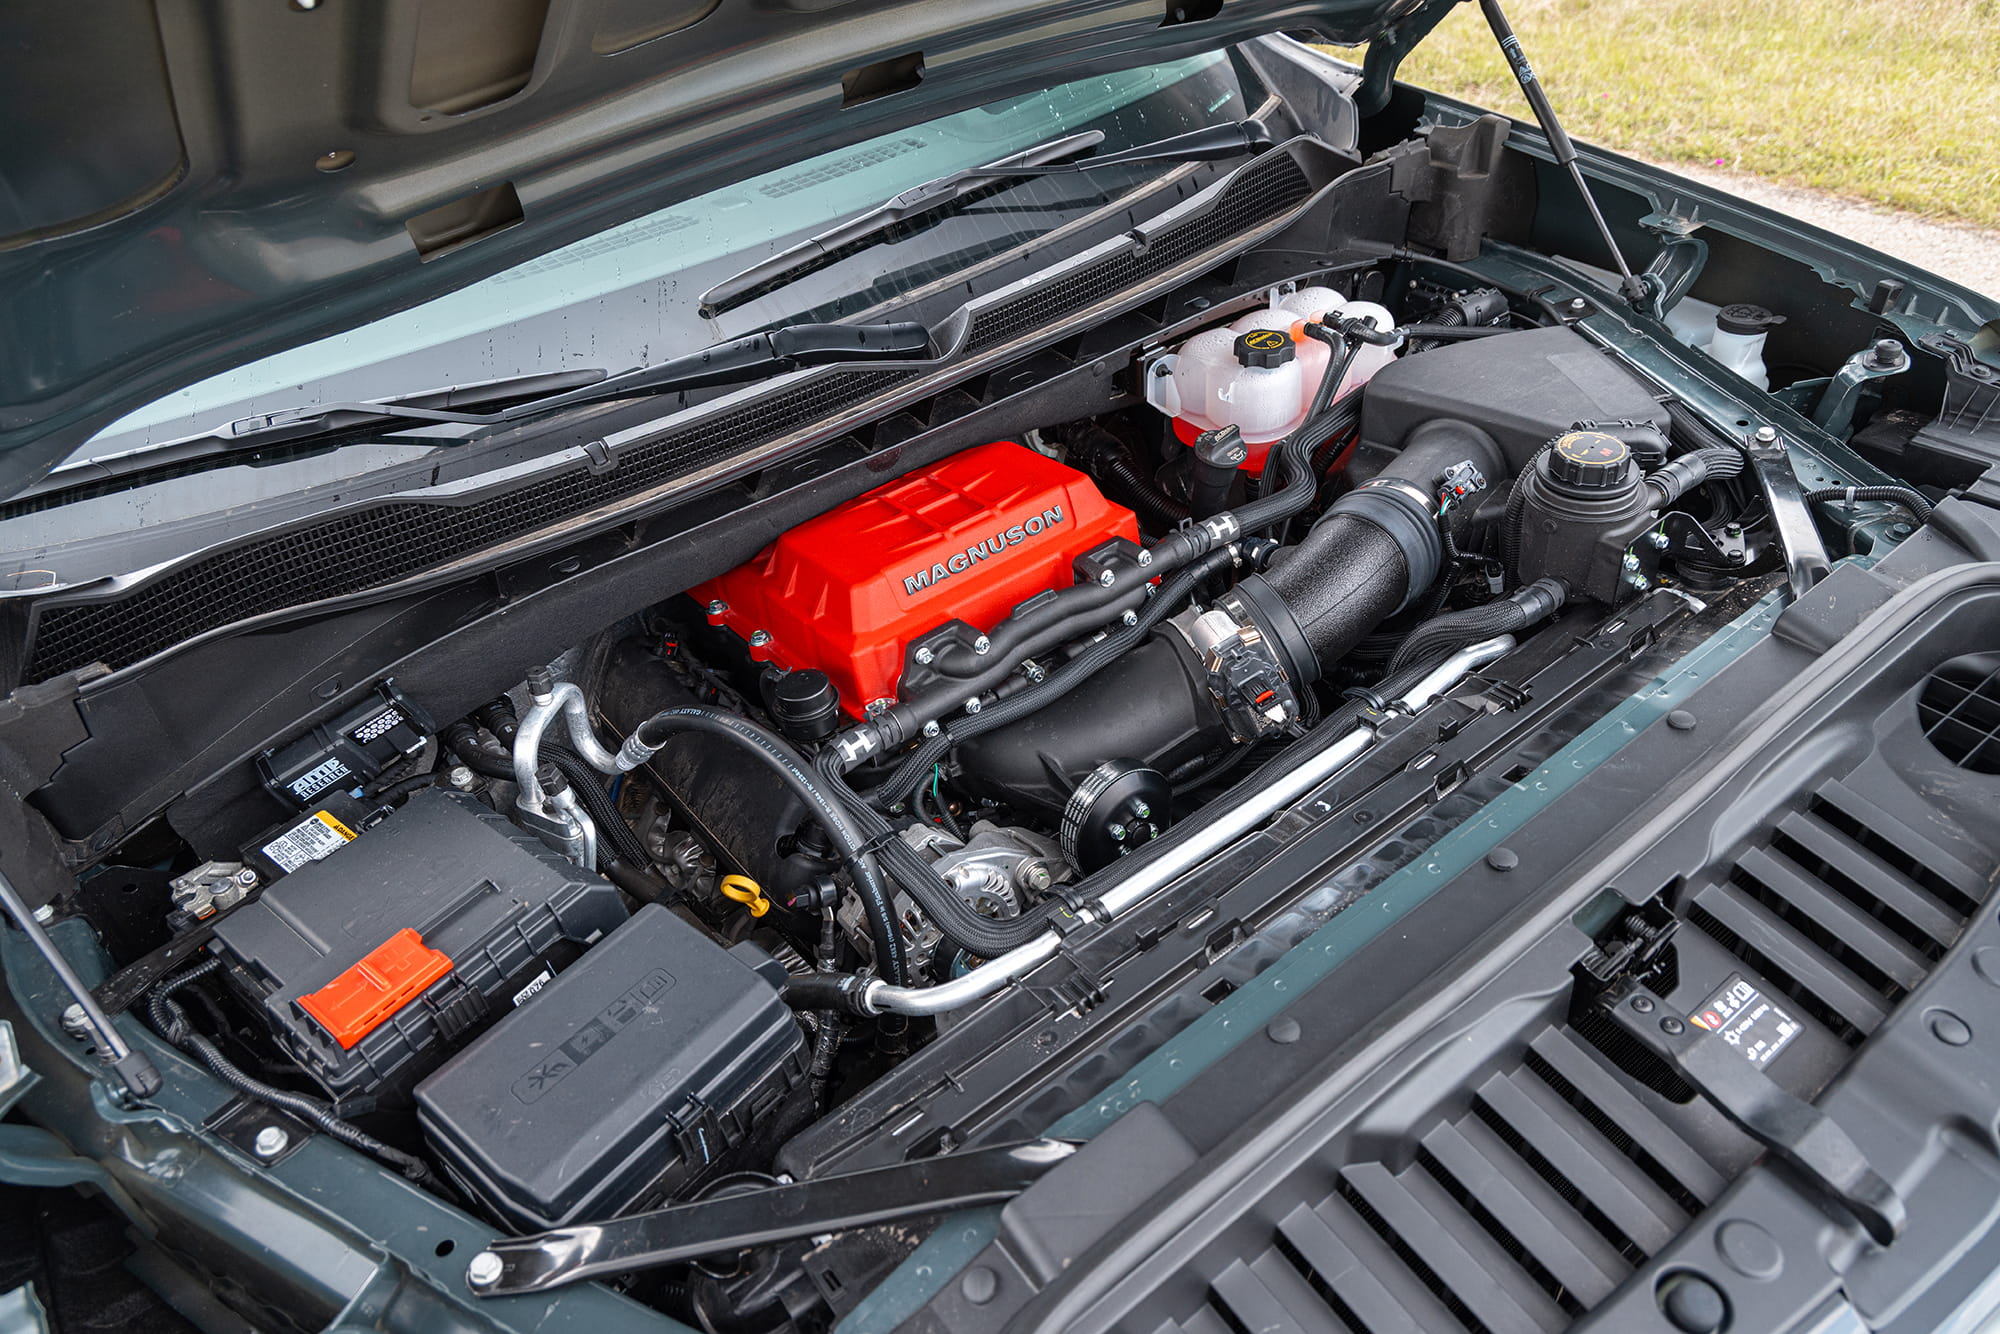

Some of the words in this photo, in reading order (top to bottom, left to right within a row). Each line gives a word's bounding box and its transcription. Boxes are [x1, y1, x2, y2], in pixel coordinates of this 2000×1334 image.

[902, 504, 1065, 596] MAGNUSON
[300, 765, 351, 798] RESEARCH
[337, 826, 355, 841] DANGE
[829, 812, 845, 831] HOSE
[841, 829, 857, 853] CTION
[865, 871, 883, 906] Flexbarrier
